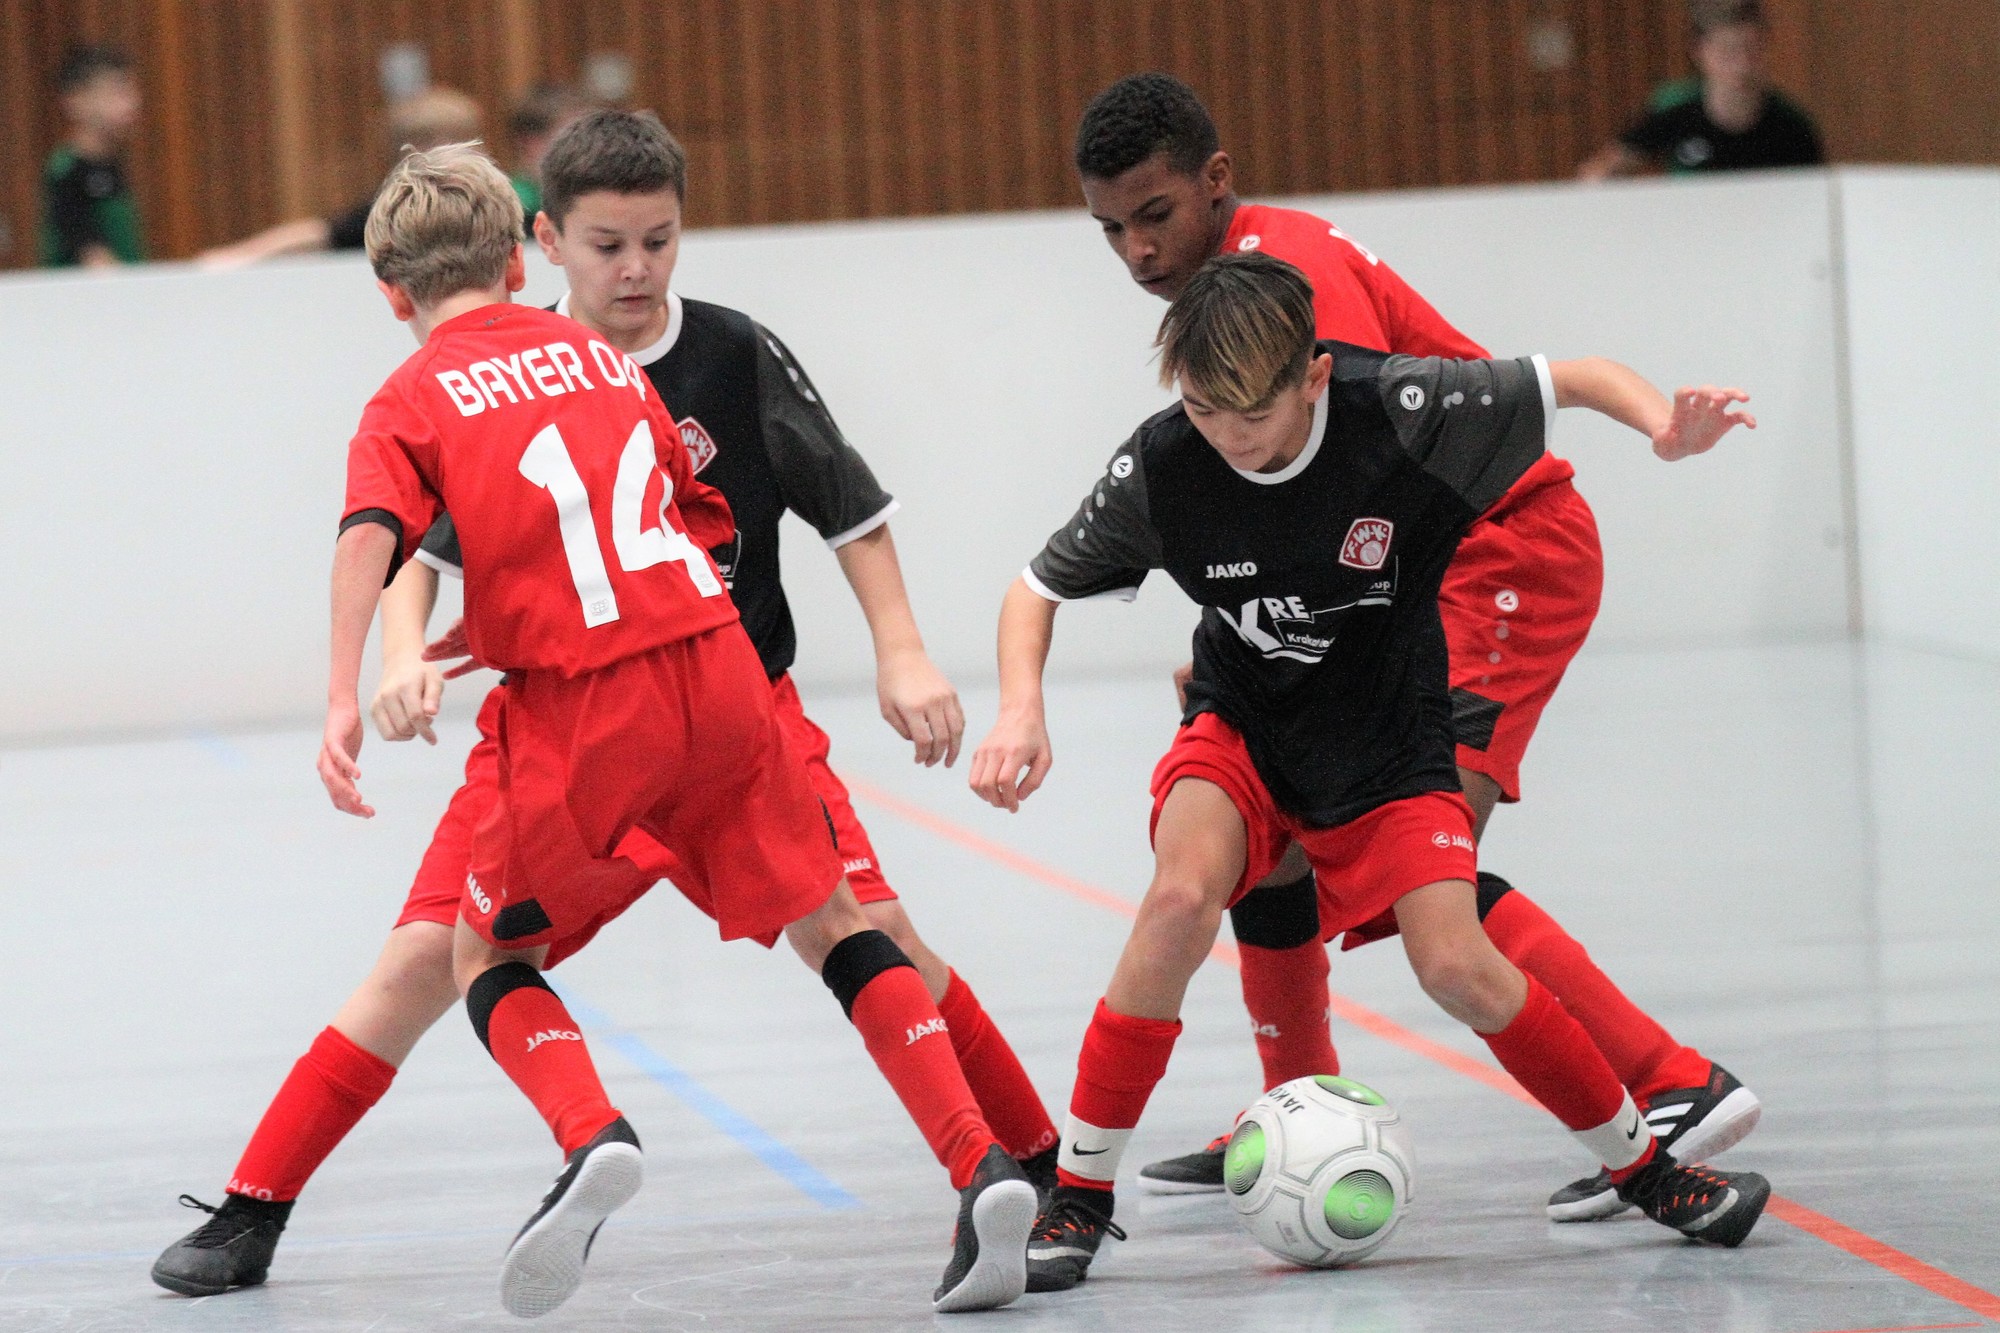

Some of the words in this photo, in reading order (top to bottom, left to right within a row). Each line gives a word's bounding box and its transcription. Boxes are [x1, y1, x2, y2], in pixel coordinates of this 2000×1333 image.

[435, 341, 595, 417] BAYER
[588, 339, 646, 402] 04
[518, 419, 723, 630] 14
[1205, 561, 1258, 579] JAKO
[526, 1028, 583, 1053] JAKO
[1268, 1087, 1305, 1114] JAKO
[1013, 1129, 1054, 1160] AKO
[228, 1178, 273, 1202] AKO
